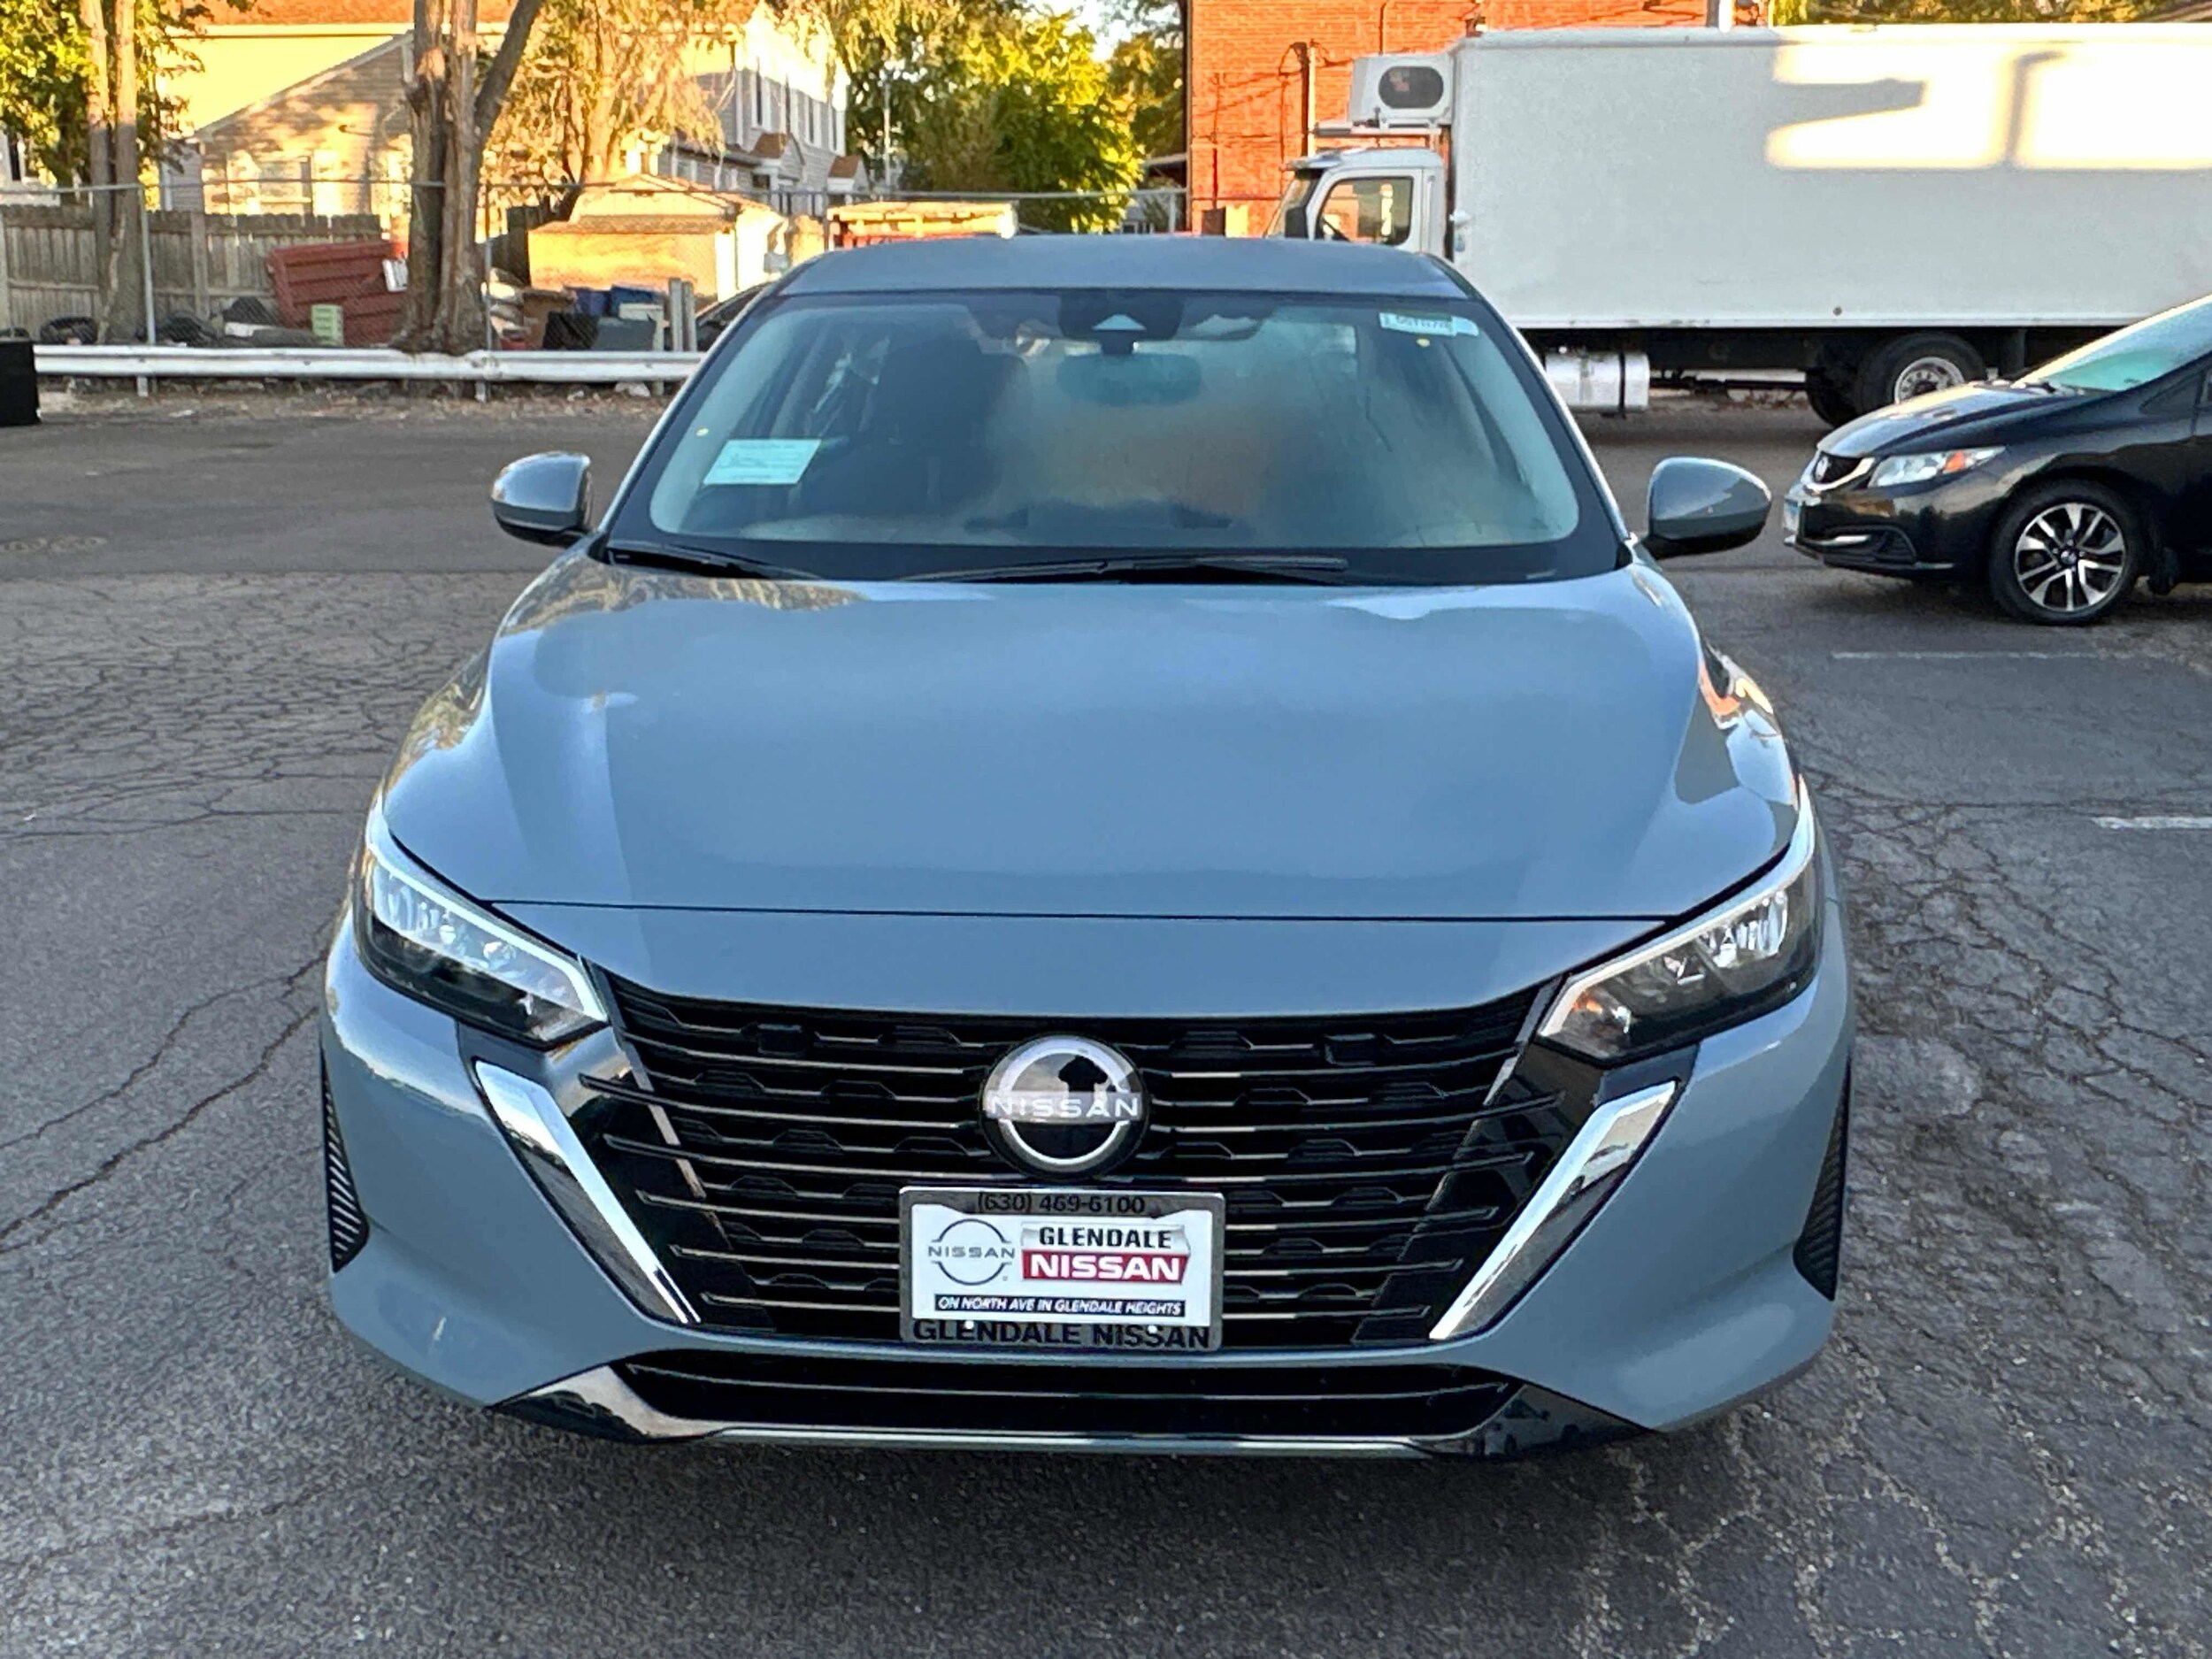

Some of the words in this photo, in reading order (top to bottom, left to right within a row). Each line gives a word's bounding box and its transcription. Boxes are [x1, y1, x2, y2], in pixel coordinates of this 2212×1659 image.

[987, 1095, 1139, 1118] NISSAN
[978, 1191, 1032, 1213] (630)
[1039, 1194, 1145, 1214] 469-6100
[1039, 1226, 1171, 1249] GLENDALE
[928, 1245, 1016, 1259] NISSAN
[1030, 1254, 1180, 1281] NISSAN
[938, 1296, 960, 1310] ON
[961, 1297, 1007, 1310] NORTH
[1009, 1298, 1035, 1311] AVE
[1036, 1299, 1053, 1311] IN
[1054, 1299, 1123, 1314] GLENDALE
[1125, 1302, 1182, 1317] HEIGHTS
[913, 1318, 1081, 1344] GLENDALE
[1093, 1325, 1210, 1348] NISSAN
